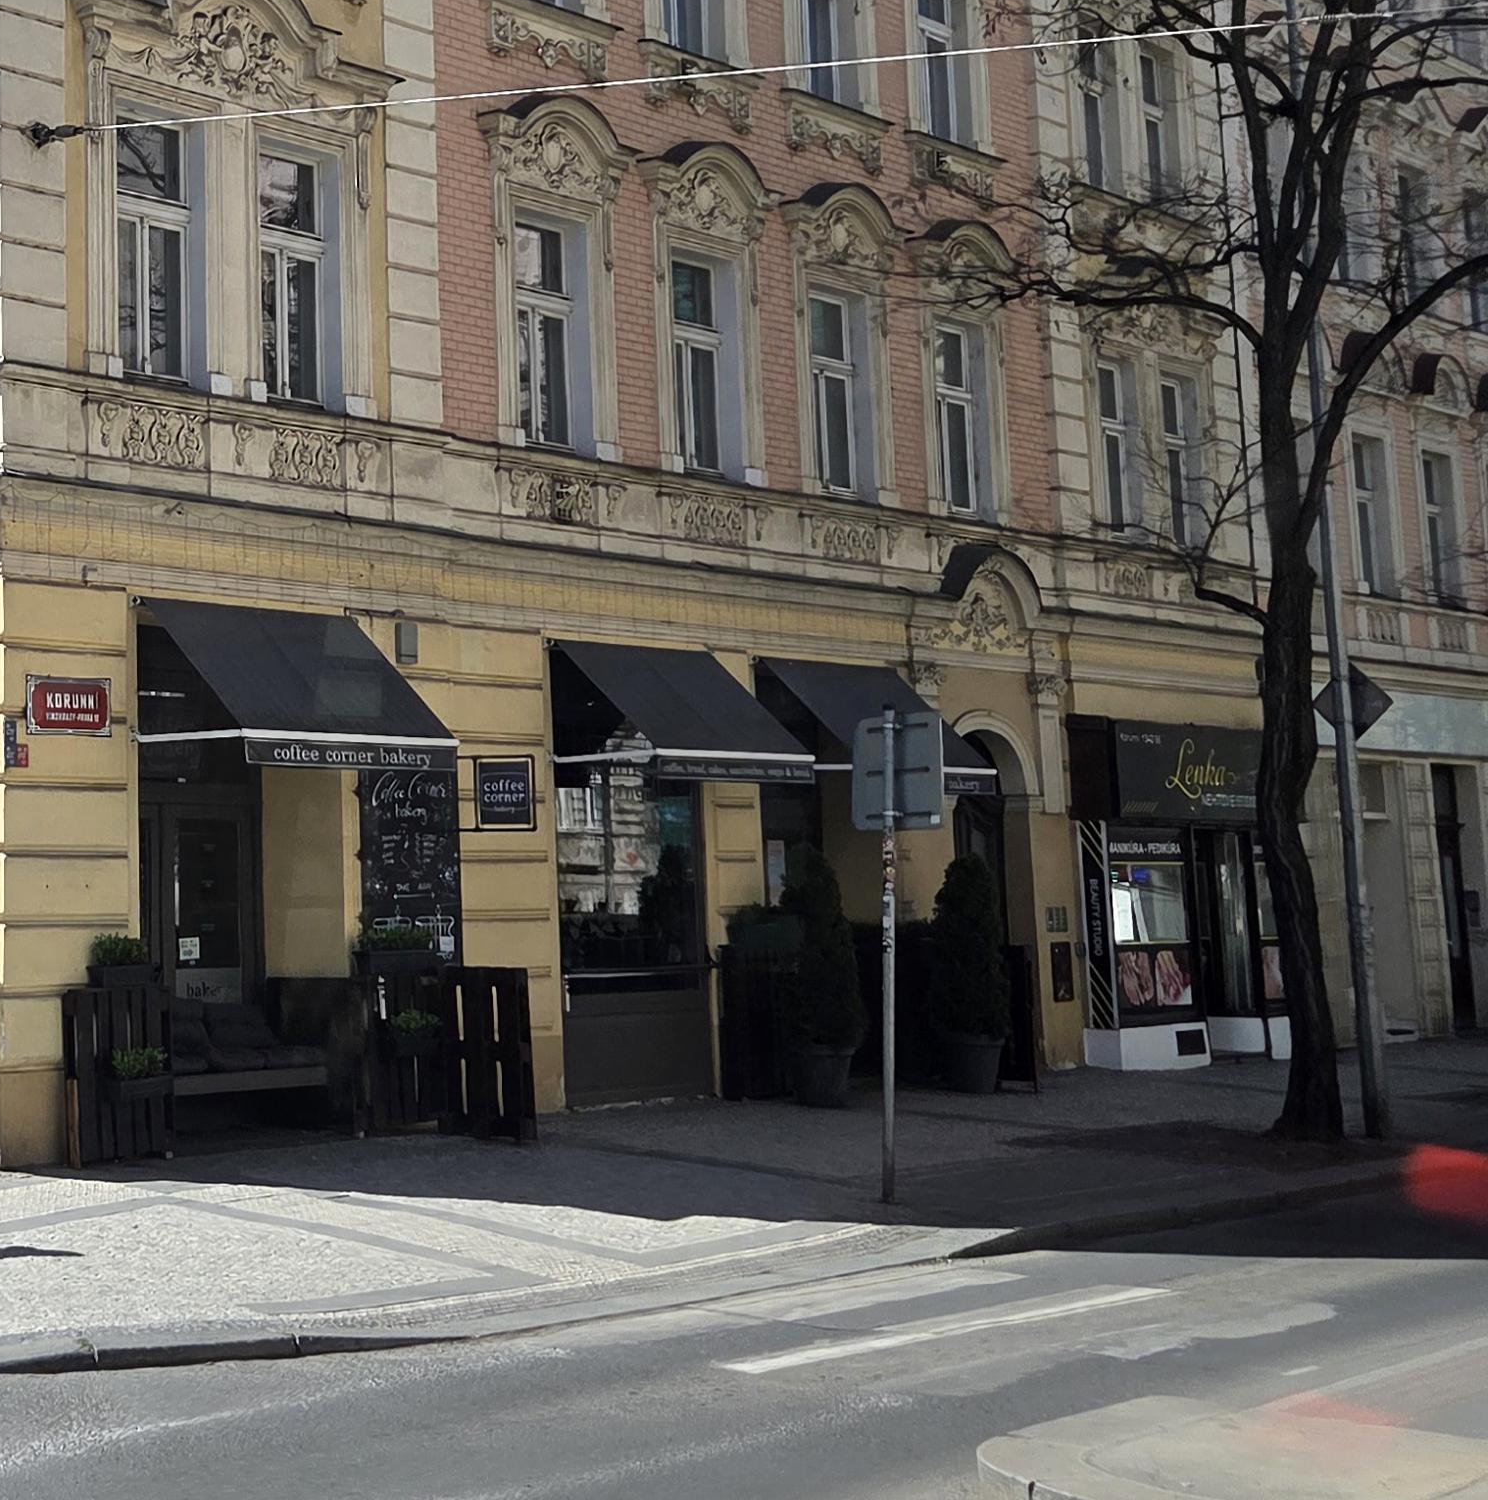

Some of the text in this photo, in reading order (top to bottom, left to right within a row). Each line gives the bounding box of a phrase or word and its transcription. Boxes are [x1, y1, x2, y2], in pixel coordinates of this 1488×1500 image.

[46, 692, 99, 709] KORUNNÍ
[273, 744, 432, 769] coffee corner bakery
[1165, 738, 1226, 799] Lenka
[483, 779, 525, 792] coffee
[484, 793, 525, 803] corner
[1089, 878, 1104, 957] BEAUTY STUDIO
